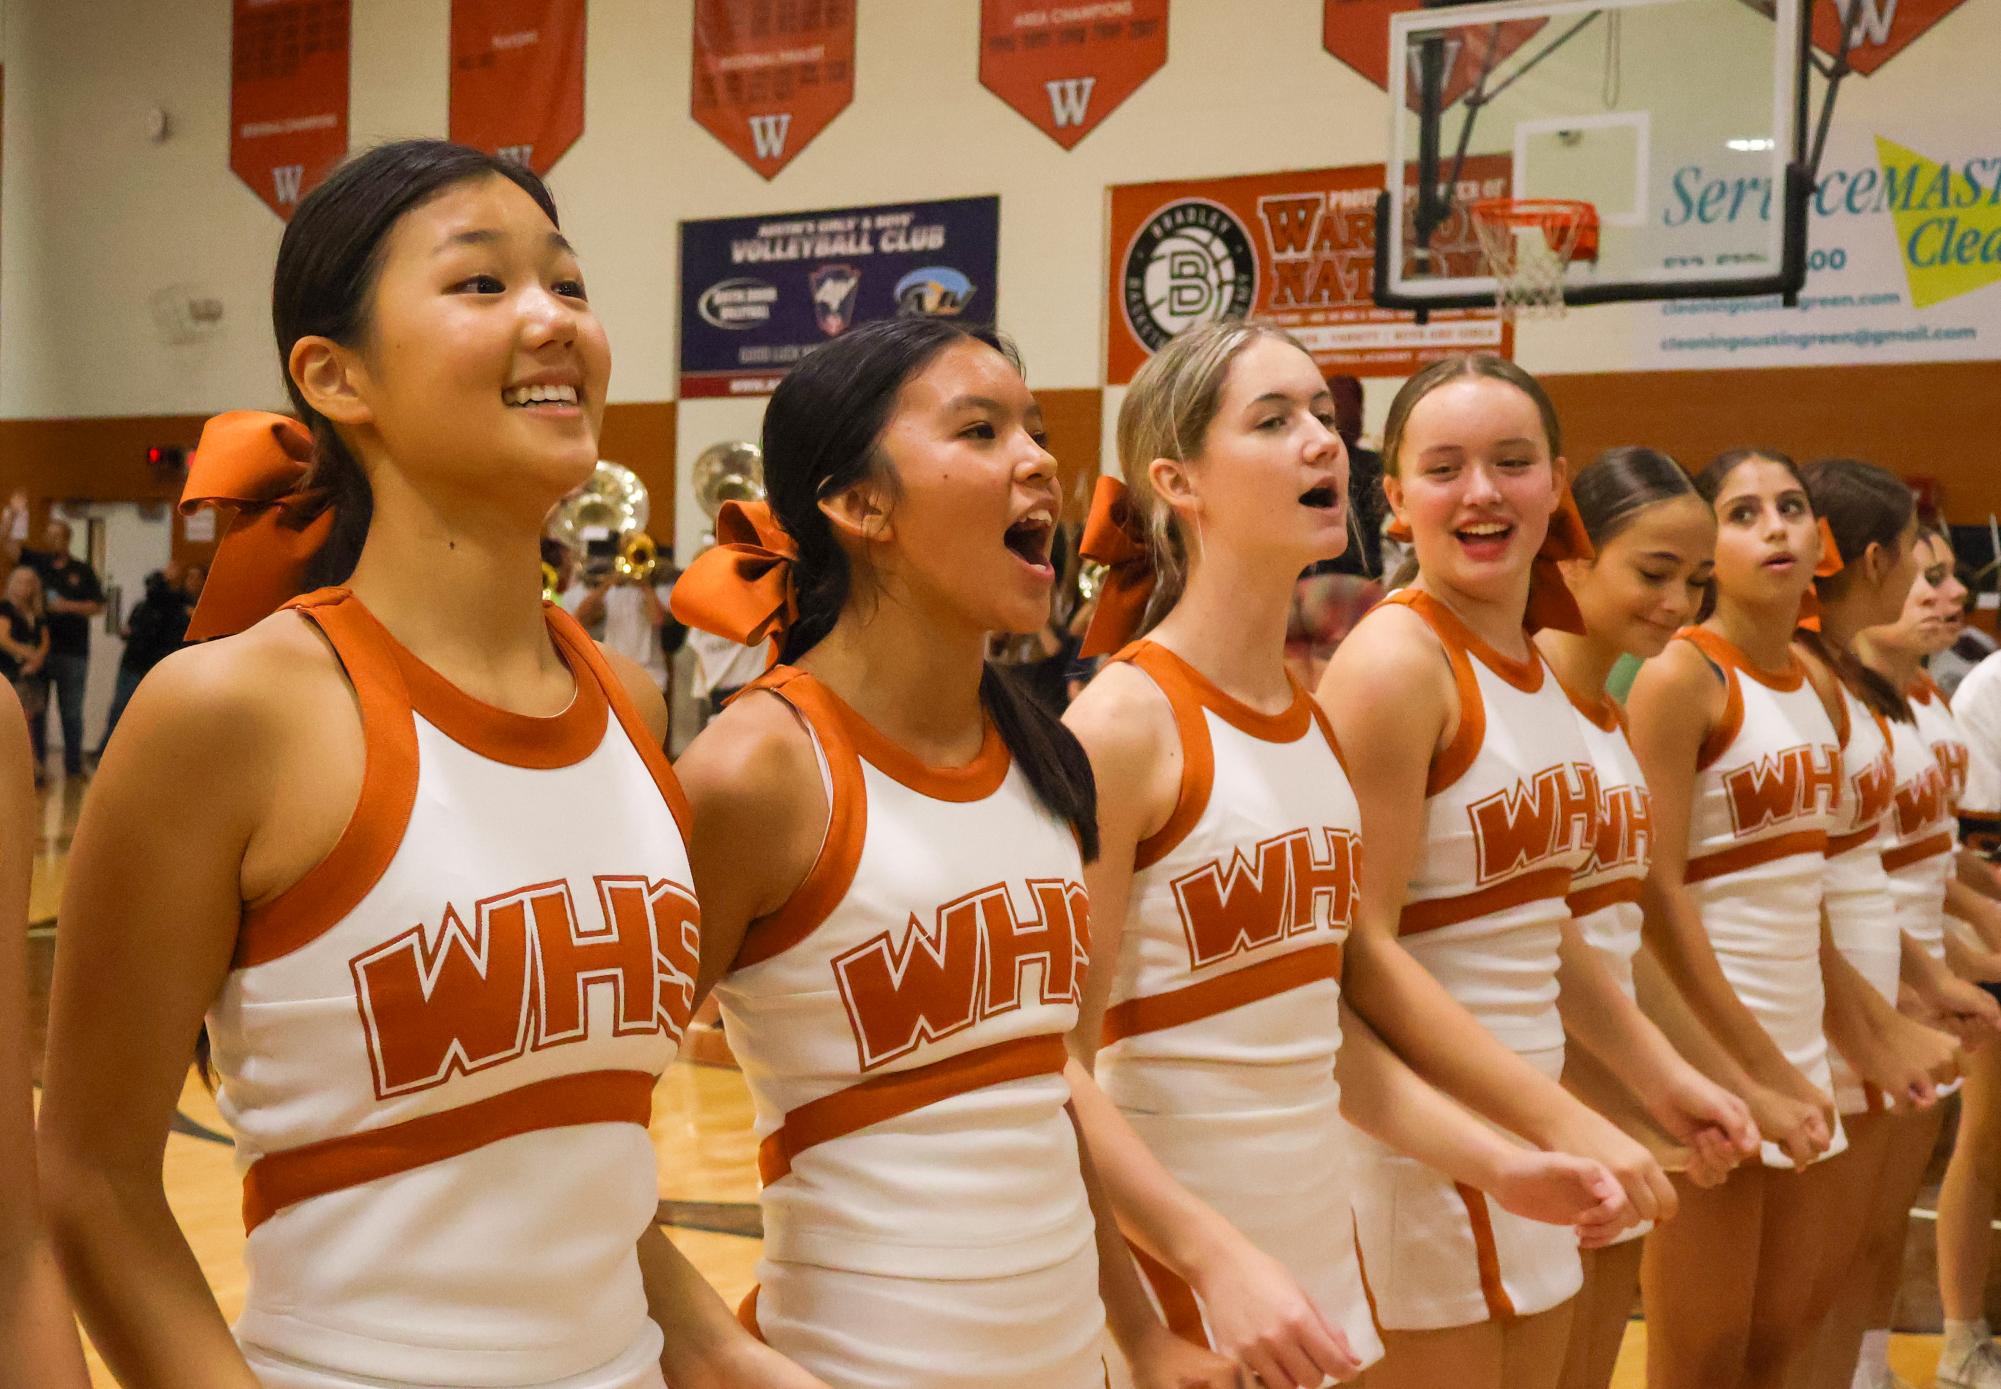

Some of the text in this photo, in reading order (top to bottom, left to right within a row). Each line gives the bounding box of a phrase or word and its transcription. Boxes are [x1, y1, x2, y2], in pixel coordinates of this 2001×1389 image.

[1046, 77, 1096, 128] W
[749, 114, 792, 160] W
[272, 164, 304, 203] W
[1151, 207, 1231, 239] BRADLEY
[731, 224, 945, 263] VOLLEYBALL CLUB
[1660, 325, 1977, 352] cleaningaustingreen@gmail.com
